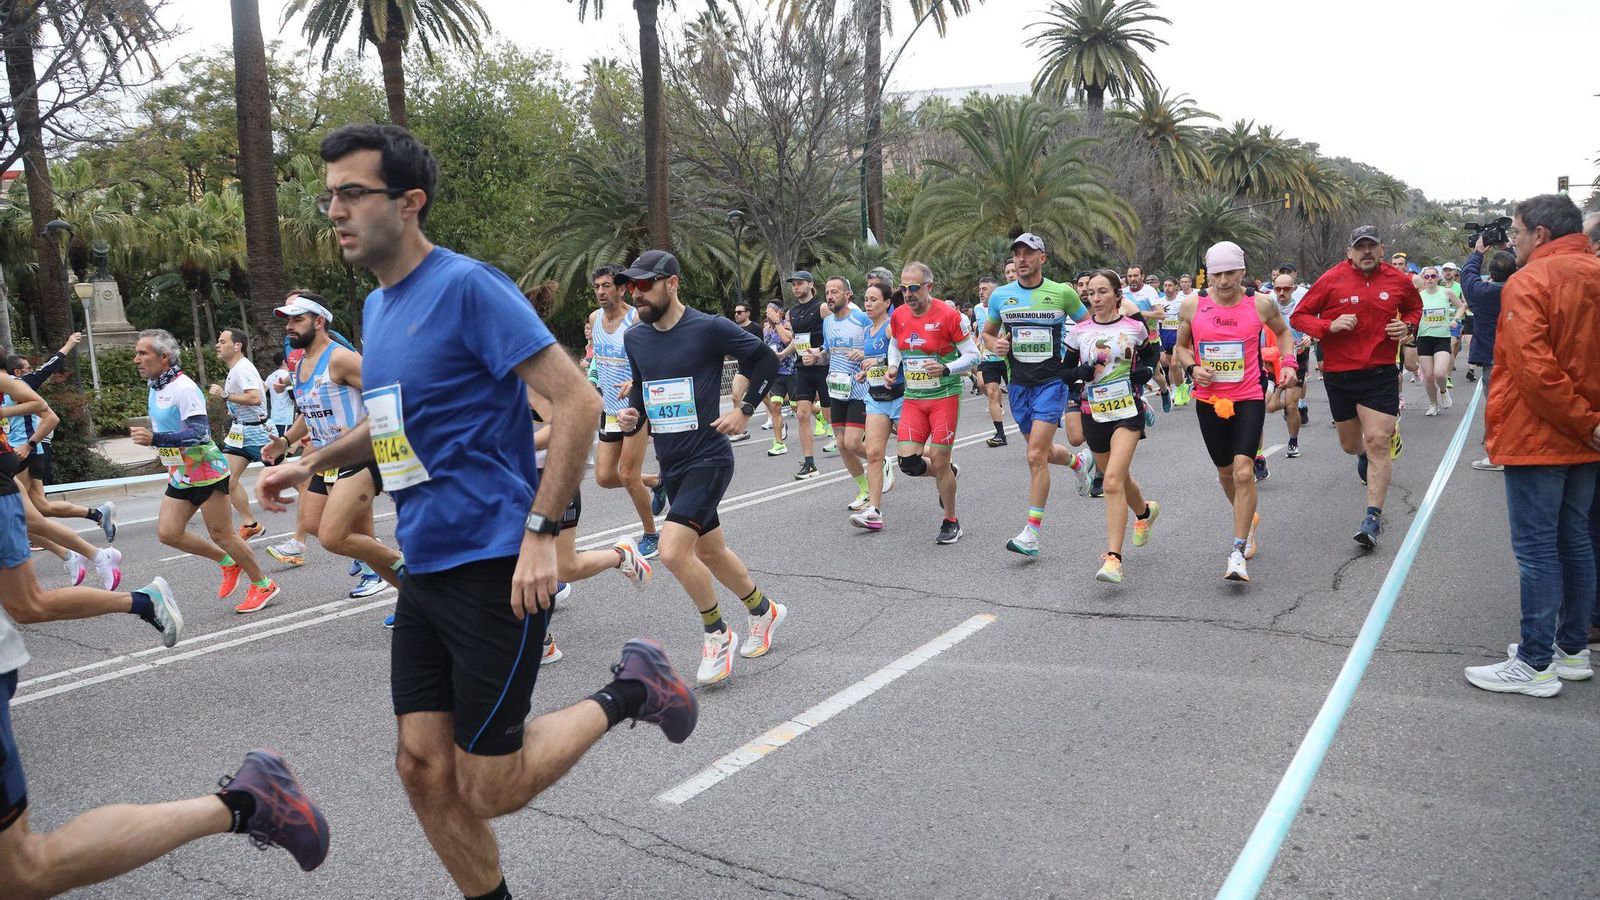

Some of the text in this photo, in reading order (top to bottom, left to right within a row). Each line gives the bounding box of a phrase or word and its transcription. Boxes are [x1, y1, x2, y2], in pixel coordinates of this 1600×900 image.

[1020, 344, 1046, 352] 6165
[659, 404, 681, 418] 437
[1099, 398, 1127, 412] 3121
